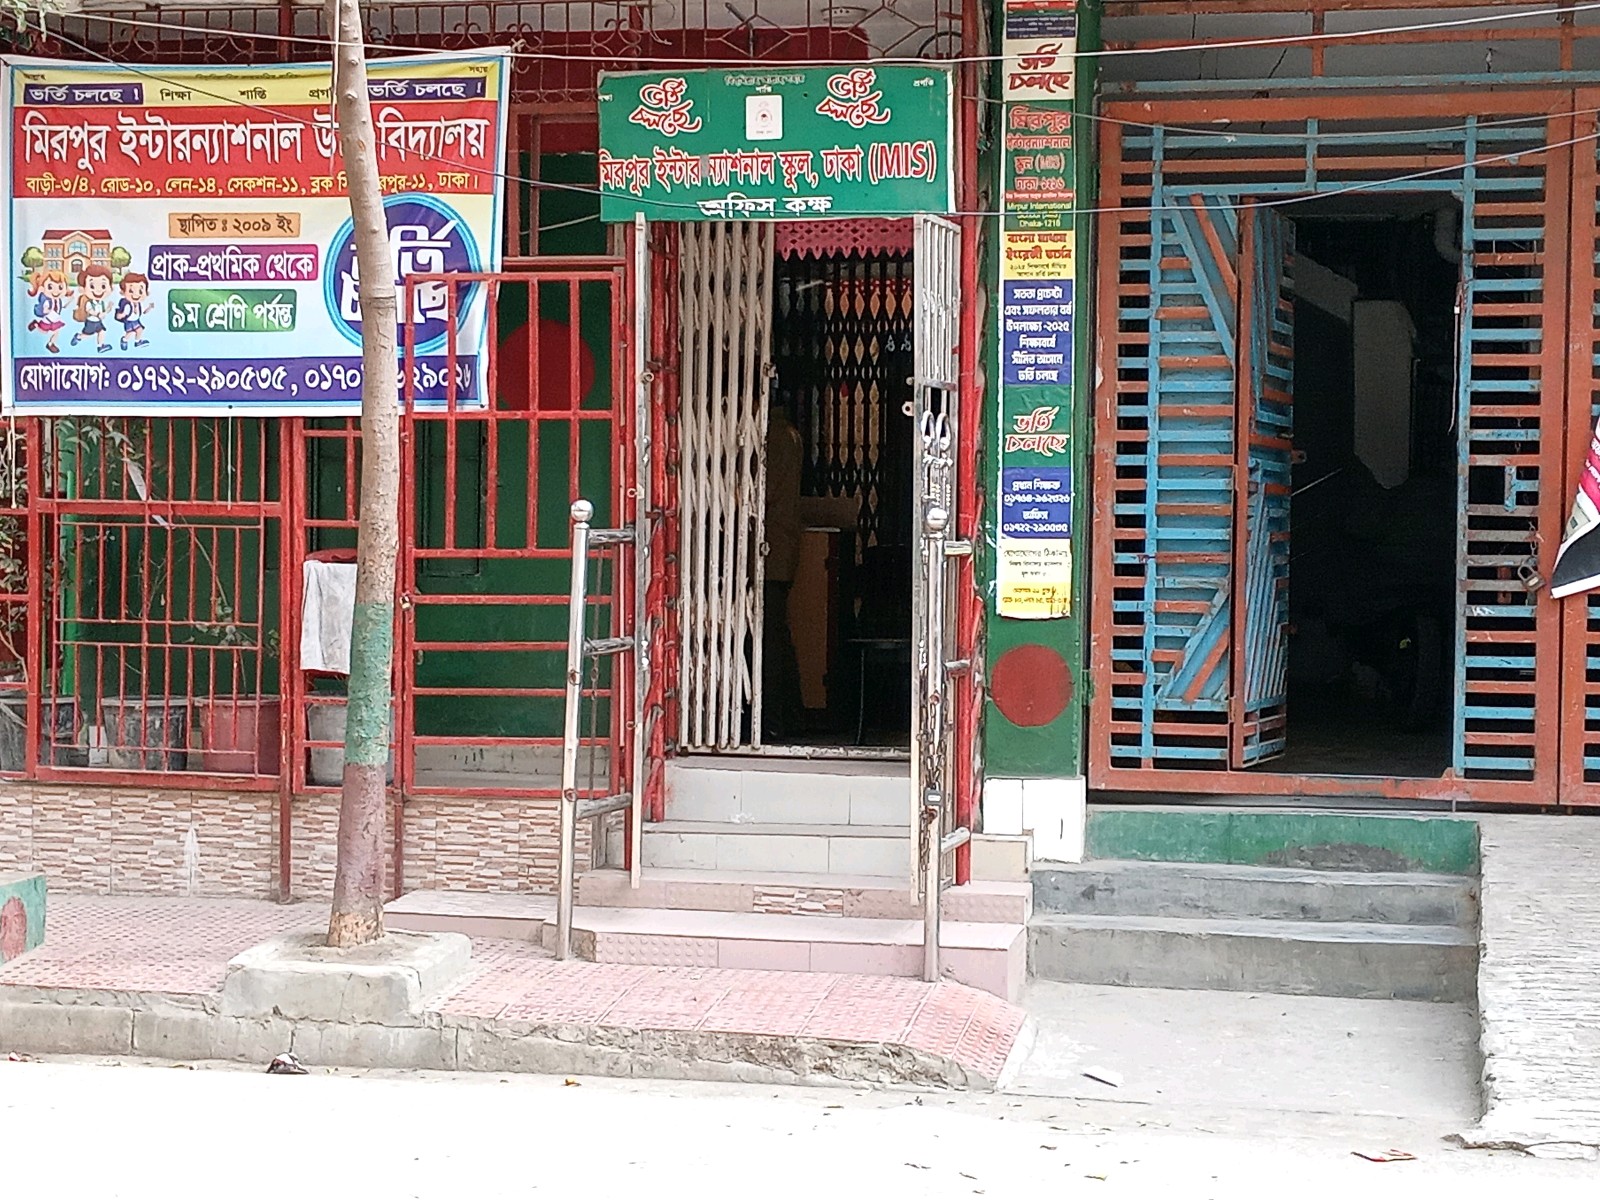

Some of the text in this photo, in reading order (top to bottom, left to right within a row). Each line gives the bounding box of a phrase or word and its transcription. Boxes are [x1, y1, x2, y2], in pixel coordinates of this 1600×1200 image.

[1017, 43, 1063, 70] ভর্তি
[29, 86, 68, 102] ভর্তি
[71, 87, 123, 103] চলছে
[160, 89, 192, 101] শিক্ষা
[238, 87, 267, 100] শান্তি
[367, 80, 409, 98] ভর্তি
[412, 81, 467, 98] চলছে
[639, 78, 688, 109] ভর্তি
[826, 68, 877, 100] ভর্তি
[628, 99, 702, 137] চলছে
[815, 91, 891, 129] চলছে
[1009, 105, 1072, 134] মিরপুর
[22, 110, 111, 174] মিরপুর
[117, 106, 305, 166] ইন্টারন্যাশনাল
[375, 106, 490, 162] বিদ্যালয়
[599, 148, 652, 197] মিরপুর
[820, 144, 865, 183] ঢাকা
[867, 140, 937, 185] (MIS)
[101, 176, 161, 195] রোড-১০,
[165, 176, 223, 196] লেন-১৪,
[227, 174, 306, 196] সেকশন-১১,
[309, 175, 334, 194] ব্লক
[696, 192, 834, 219] অফিস কক্ষ
[1006, 202, 1072, 211] Mirpur International
[177, 213, 217, 235] স্থাপিত
[233, 216, 272, 233] ২০০৯
[277, 214, 294, 233] ইং
[1006, 233, 1036, 243] বাংলা
[266, 250, 315, 280] থেকে
[171, 293, 294, 330] ৯ম শ্রেণি পর্যন্ত
[1004, 305, 1021, 316] এবং
[117, 363, 299, 396] ০১৭২২-২৯০৫৩৫,
[1013, 406, 1060, 433] ভর্তি
